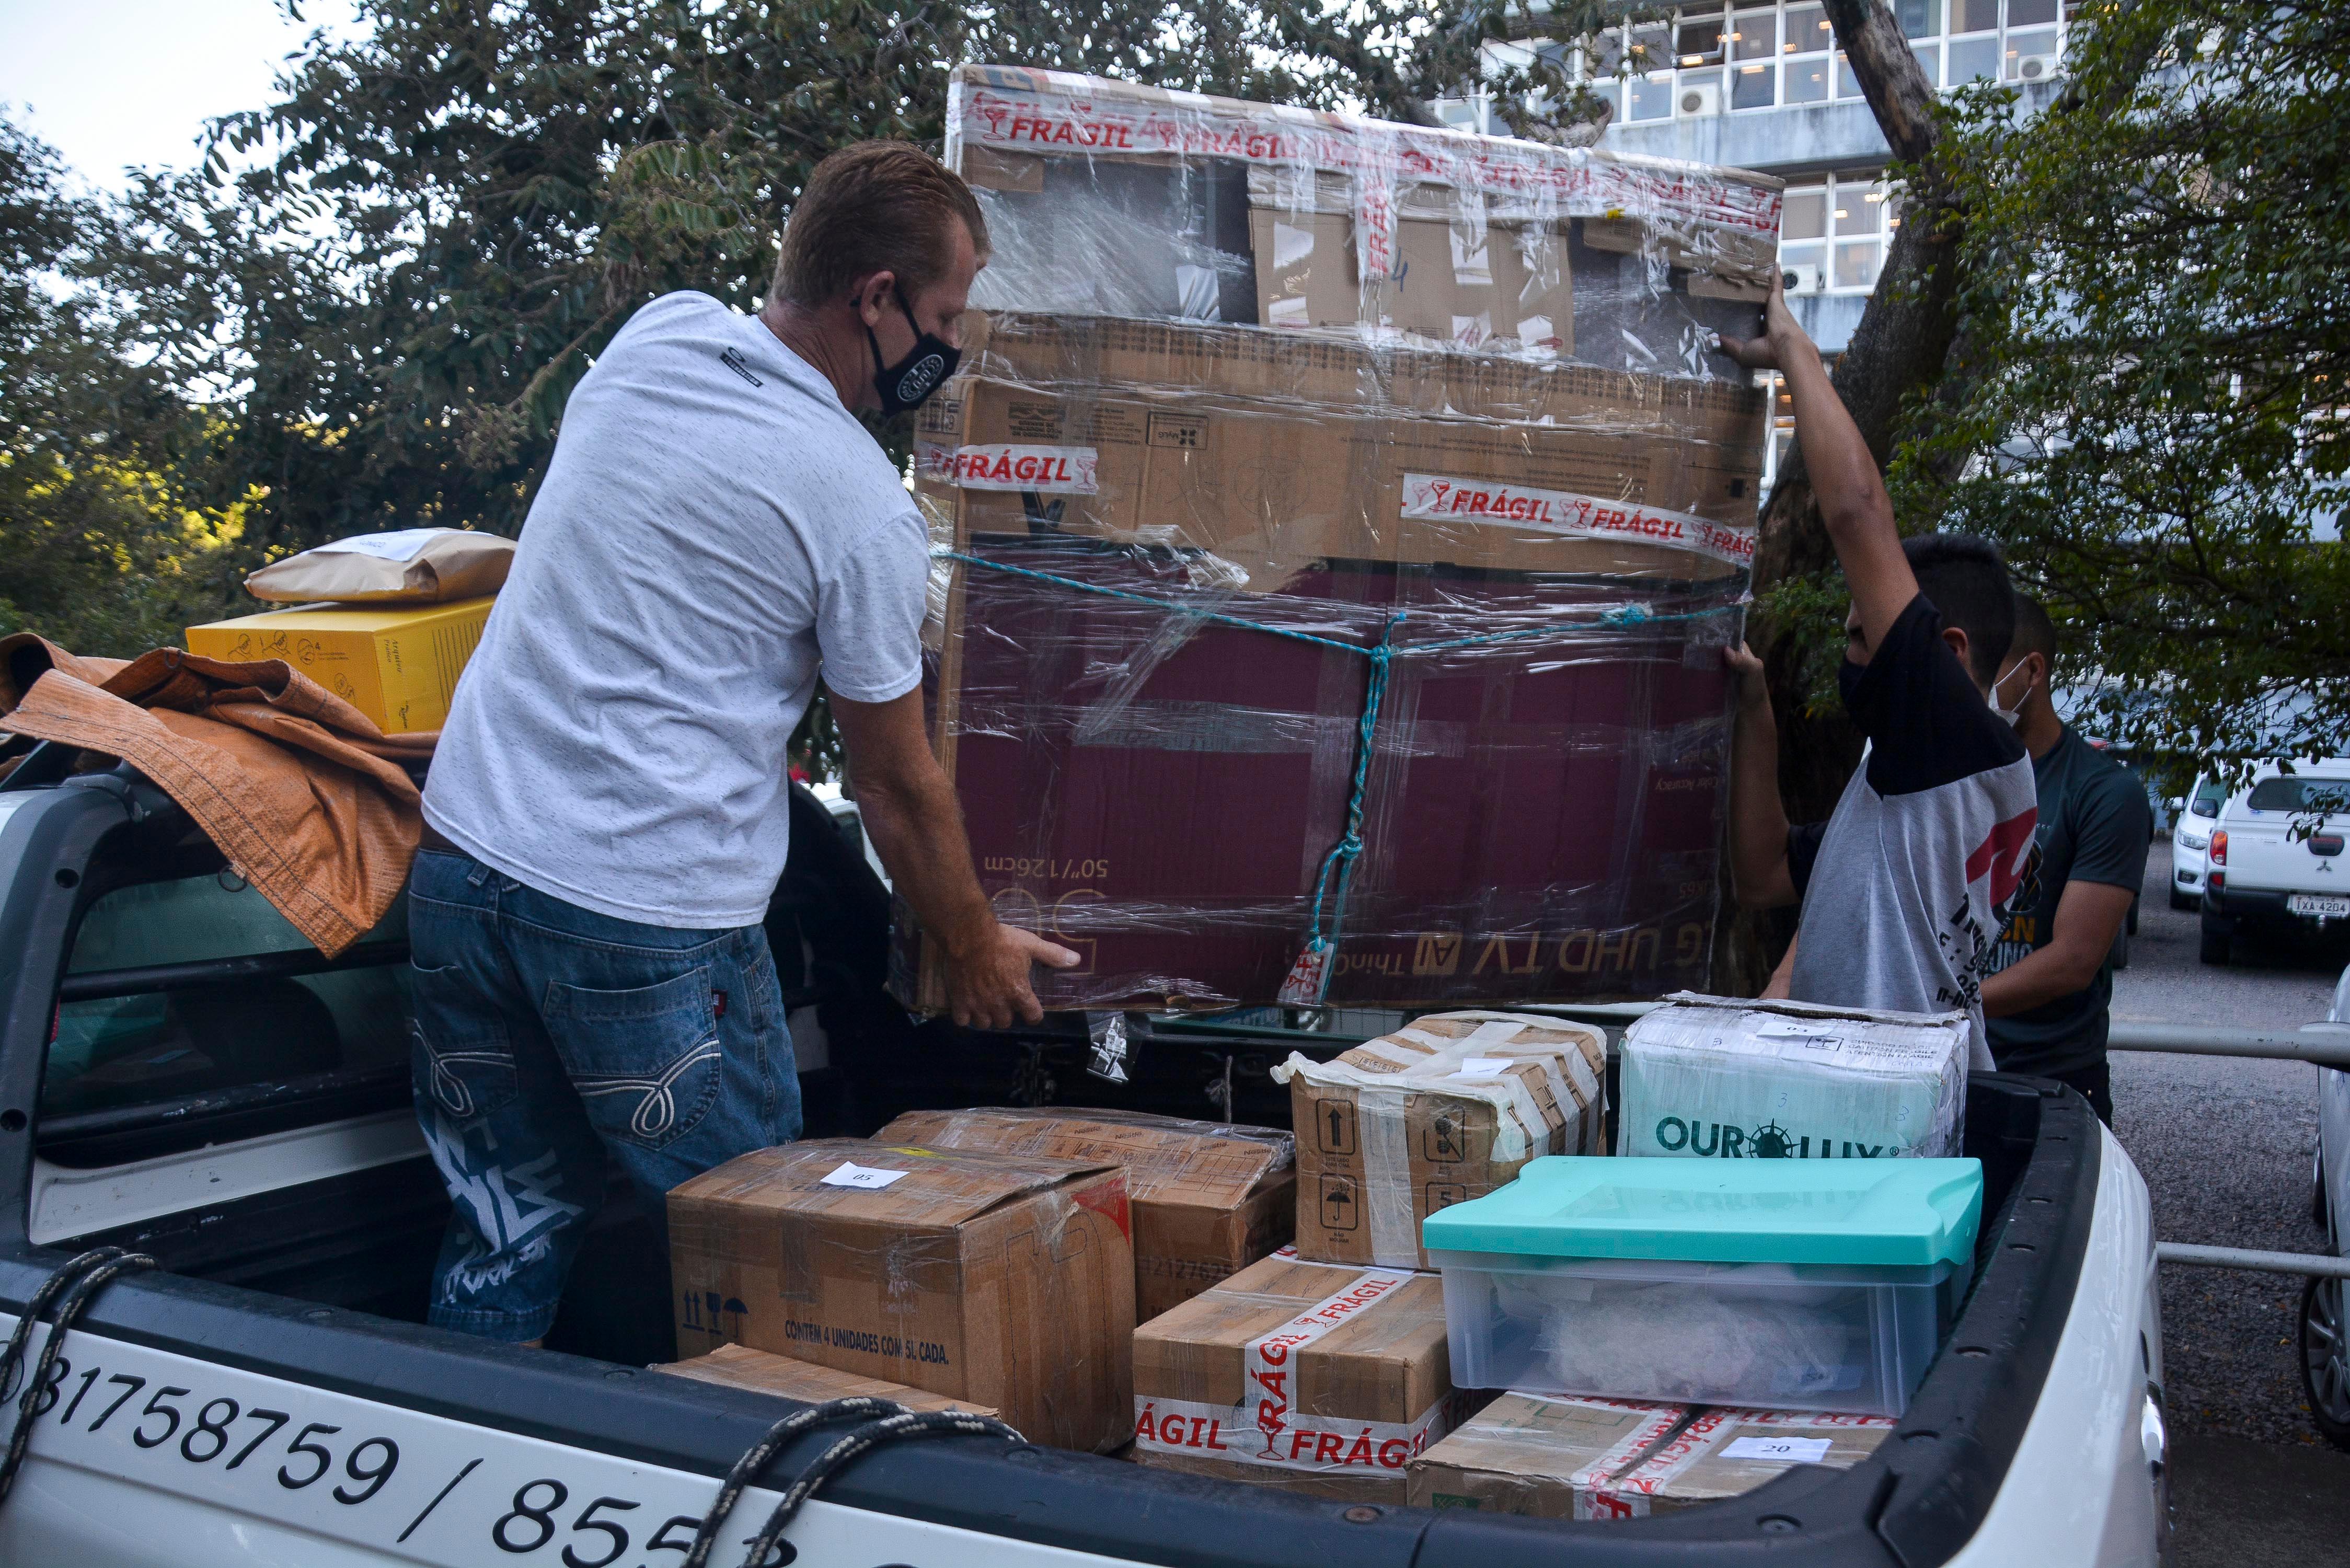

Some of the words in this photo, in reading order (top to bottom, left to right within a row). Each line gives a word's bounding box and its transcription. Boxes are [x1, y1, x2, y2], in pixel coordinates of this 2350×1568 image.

[953, 448, 1072, 482] FRÁGIL
[1450, 488, 1554, 523] FRÁGIL
[1591, 508, 1685, 539] FRÁGIL
[1471, 930, 1542, 975] TV
[1558, 927, 1661, 974] UHD
[853, 1173, 875, 1181] 05
[1317, 1277, 1398, 1320] FRÁGIL
[823, 1328, 832, 1346] 4
[833, 1328, 880, 1355] UNIDADES
[881, 1334, 903, 1358] COM
[1763, 1444, 1791, 1453] 20
